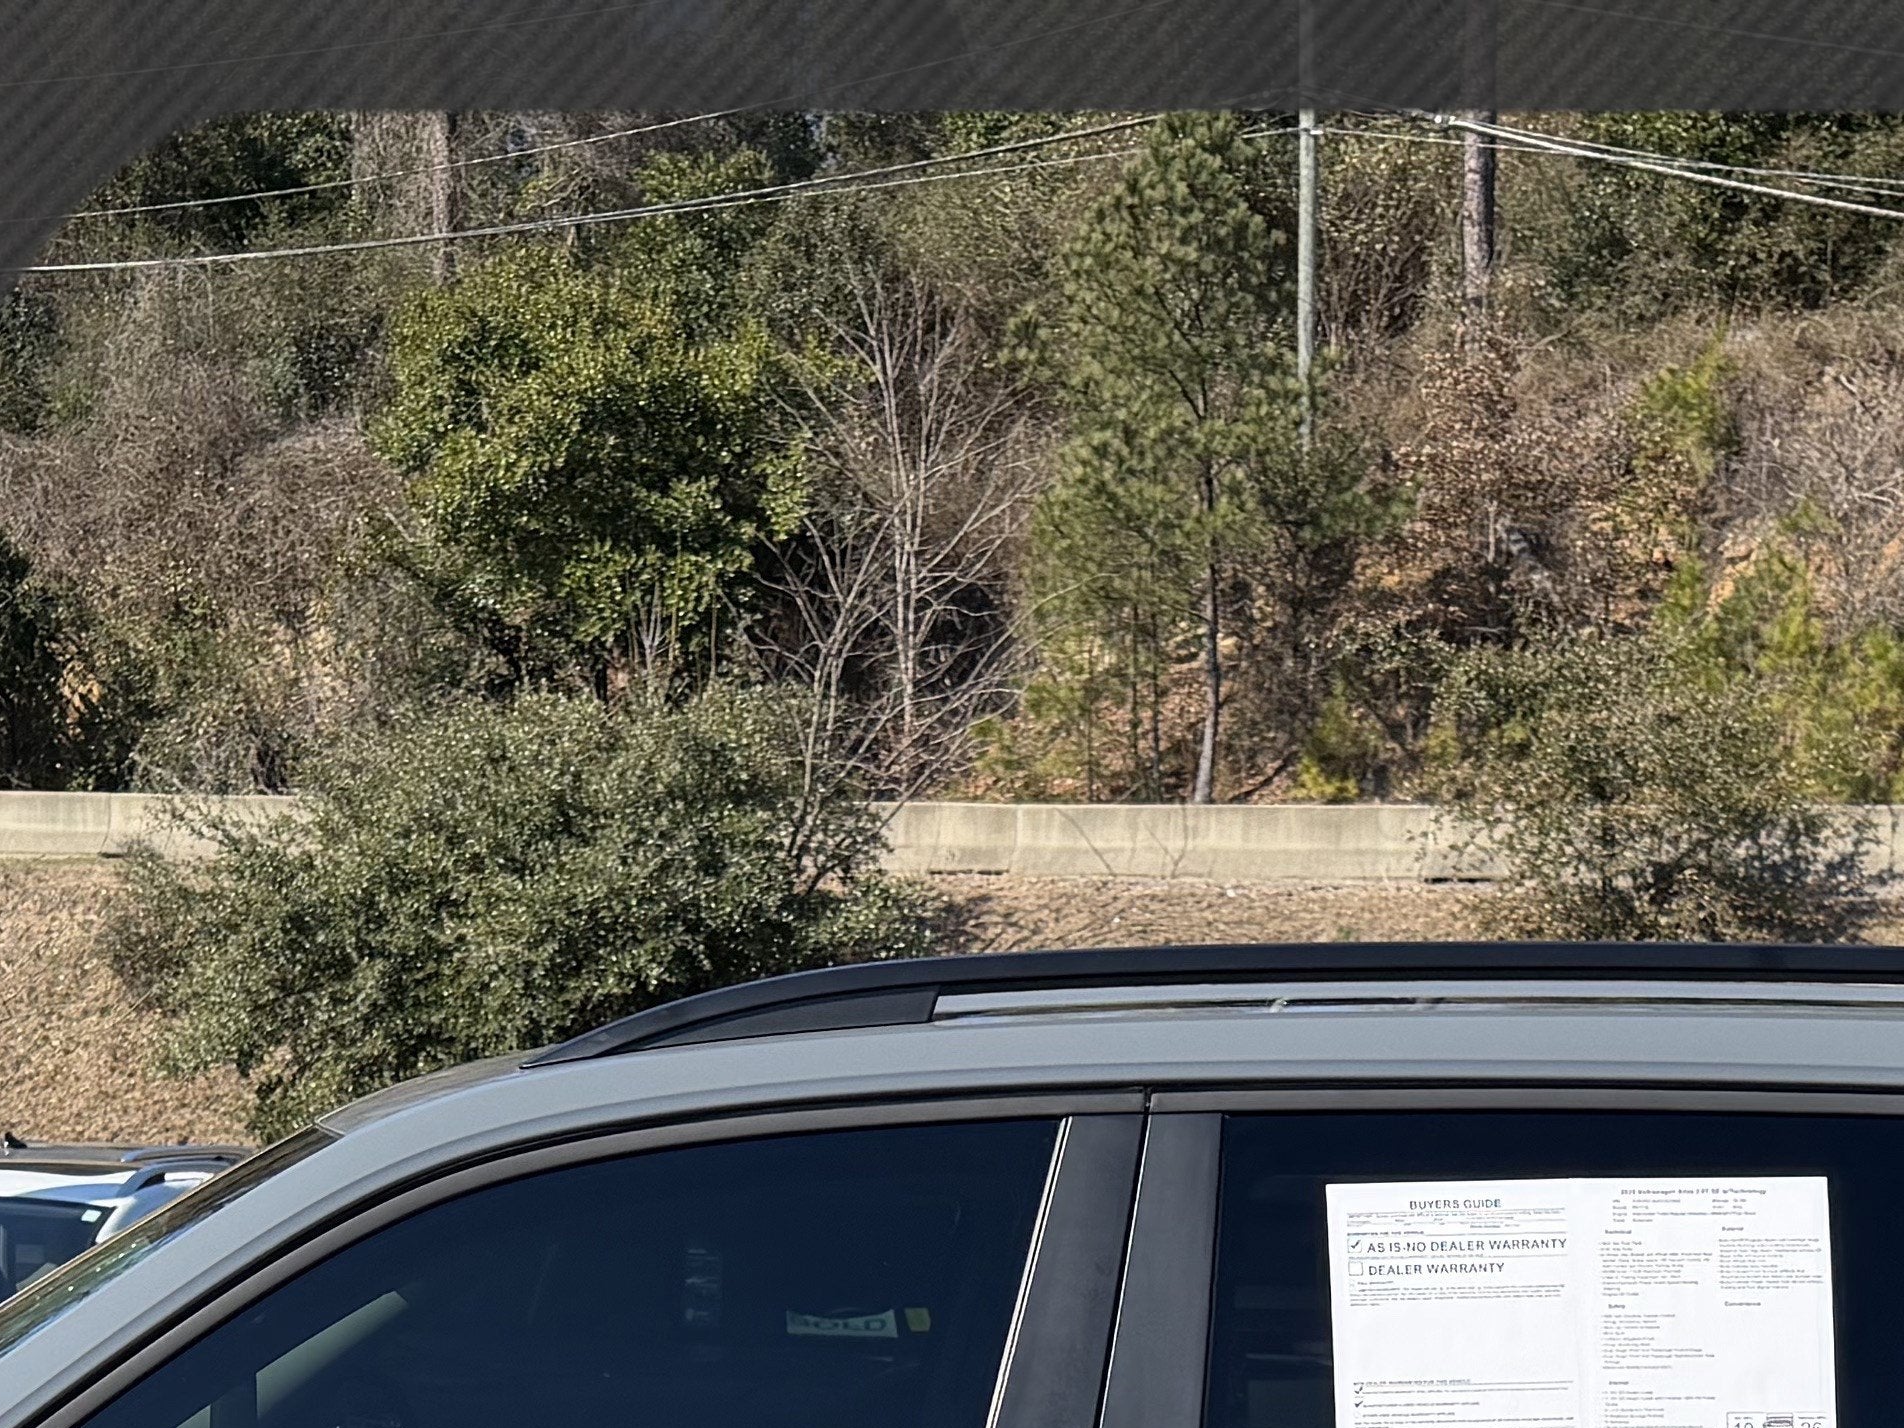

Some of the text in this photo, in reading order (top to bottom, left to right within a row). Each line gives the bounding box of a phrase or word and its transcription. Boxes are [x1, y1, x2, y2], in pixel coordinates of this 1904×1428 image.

[1409, 1198, 1502, 1209] BUYERS GUIDE
[1367, 1242, 1386, 1253] AS
[1430, 1240, 1485, 1252] DEALER
[1488, 1238, 1568, 1250] WARRANTY
[1368, 1262, 1505, 1276] DEALER WARRANTY
